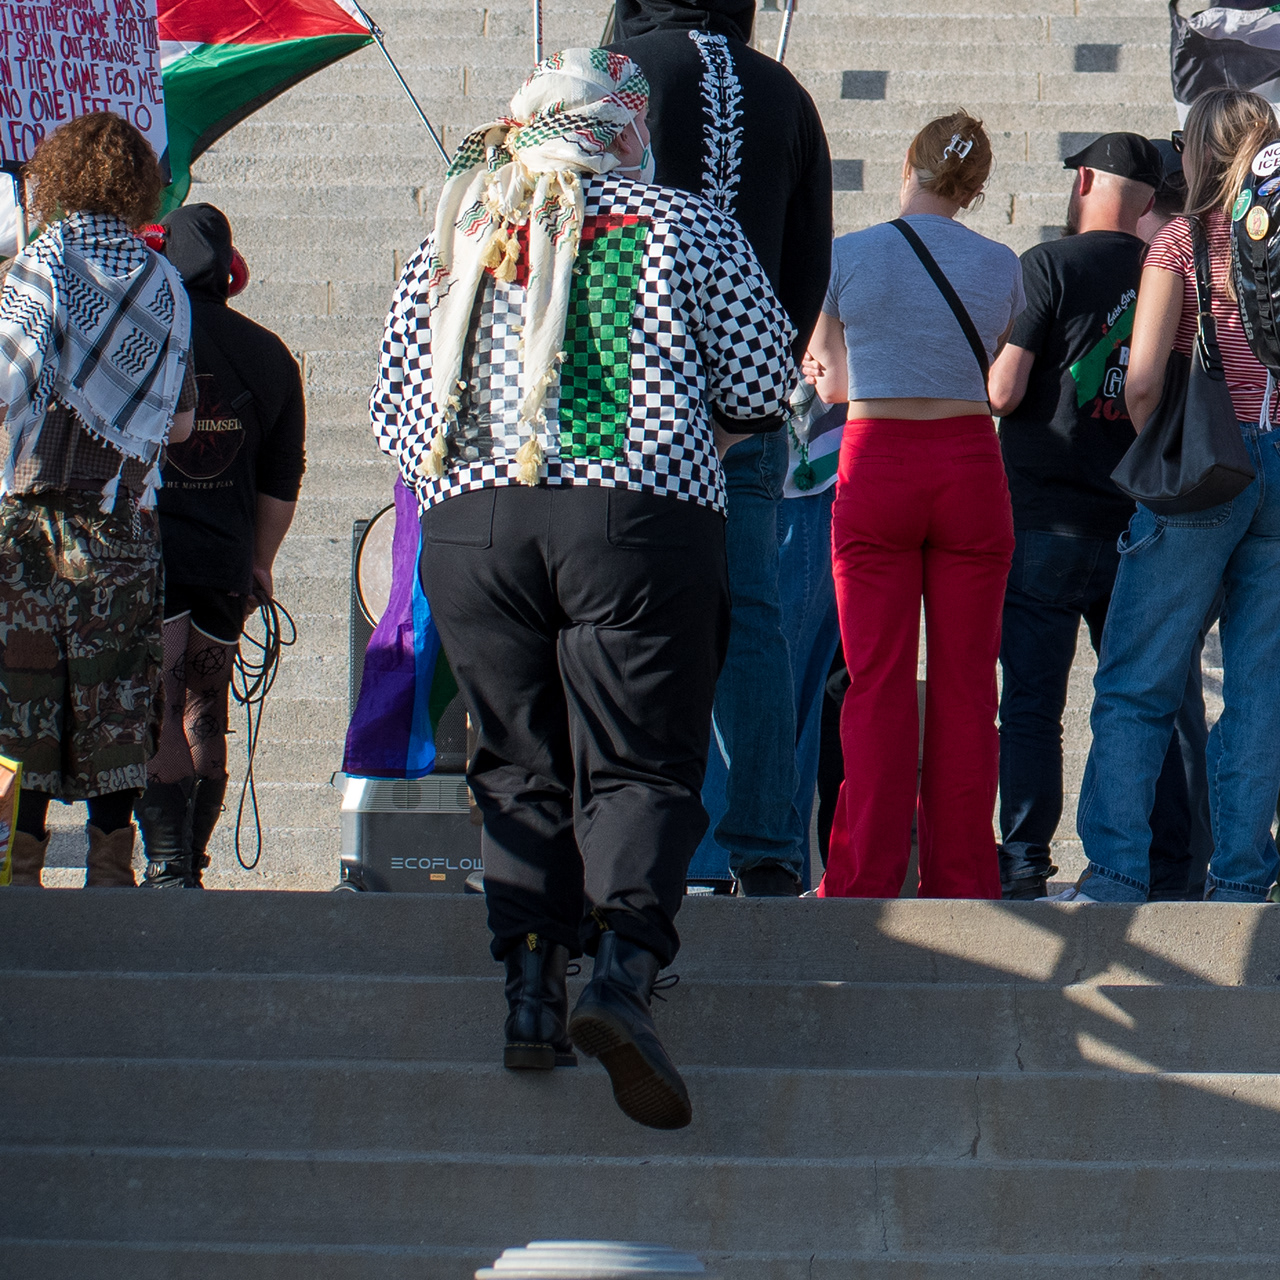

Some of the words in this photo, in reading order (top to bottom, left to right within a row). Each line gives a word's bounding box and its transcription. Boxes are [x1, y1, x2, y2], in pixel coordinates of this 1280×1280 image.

[0, 3, 40, 32] THEN
[36, 6, 69, 33] THEY
[71, 10, 110, 38] CAME
[115, 18, 142, 44] FOR
[16, 29, 56, 60] SPEAK
[144, 49, 157, 72] I
[14, 57, 57, 92] THEY
[61, 61, 100, 95] CAME
[105, 66, 135, 96] FOR
[0, 87, 22, 119] NO
[29, 90, 67, 121] ONE
[119, 101, 152, 132] TO
[1120, 289, 1137, 310] Strip
